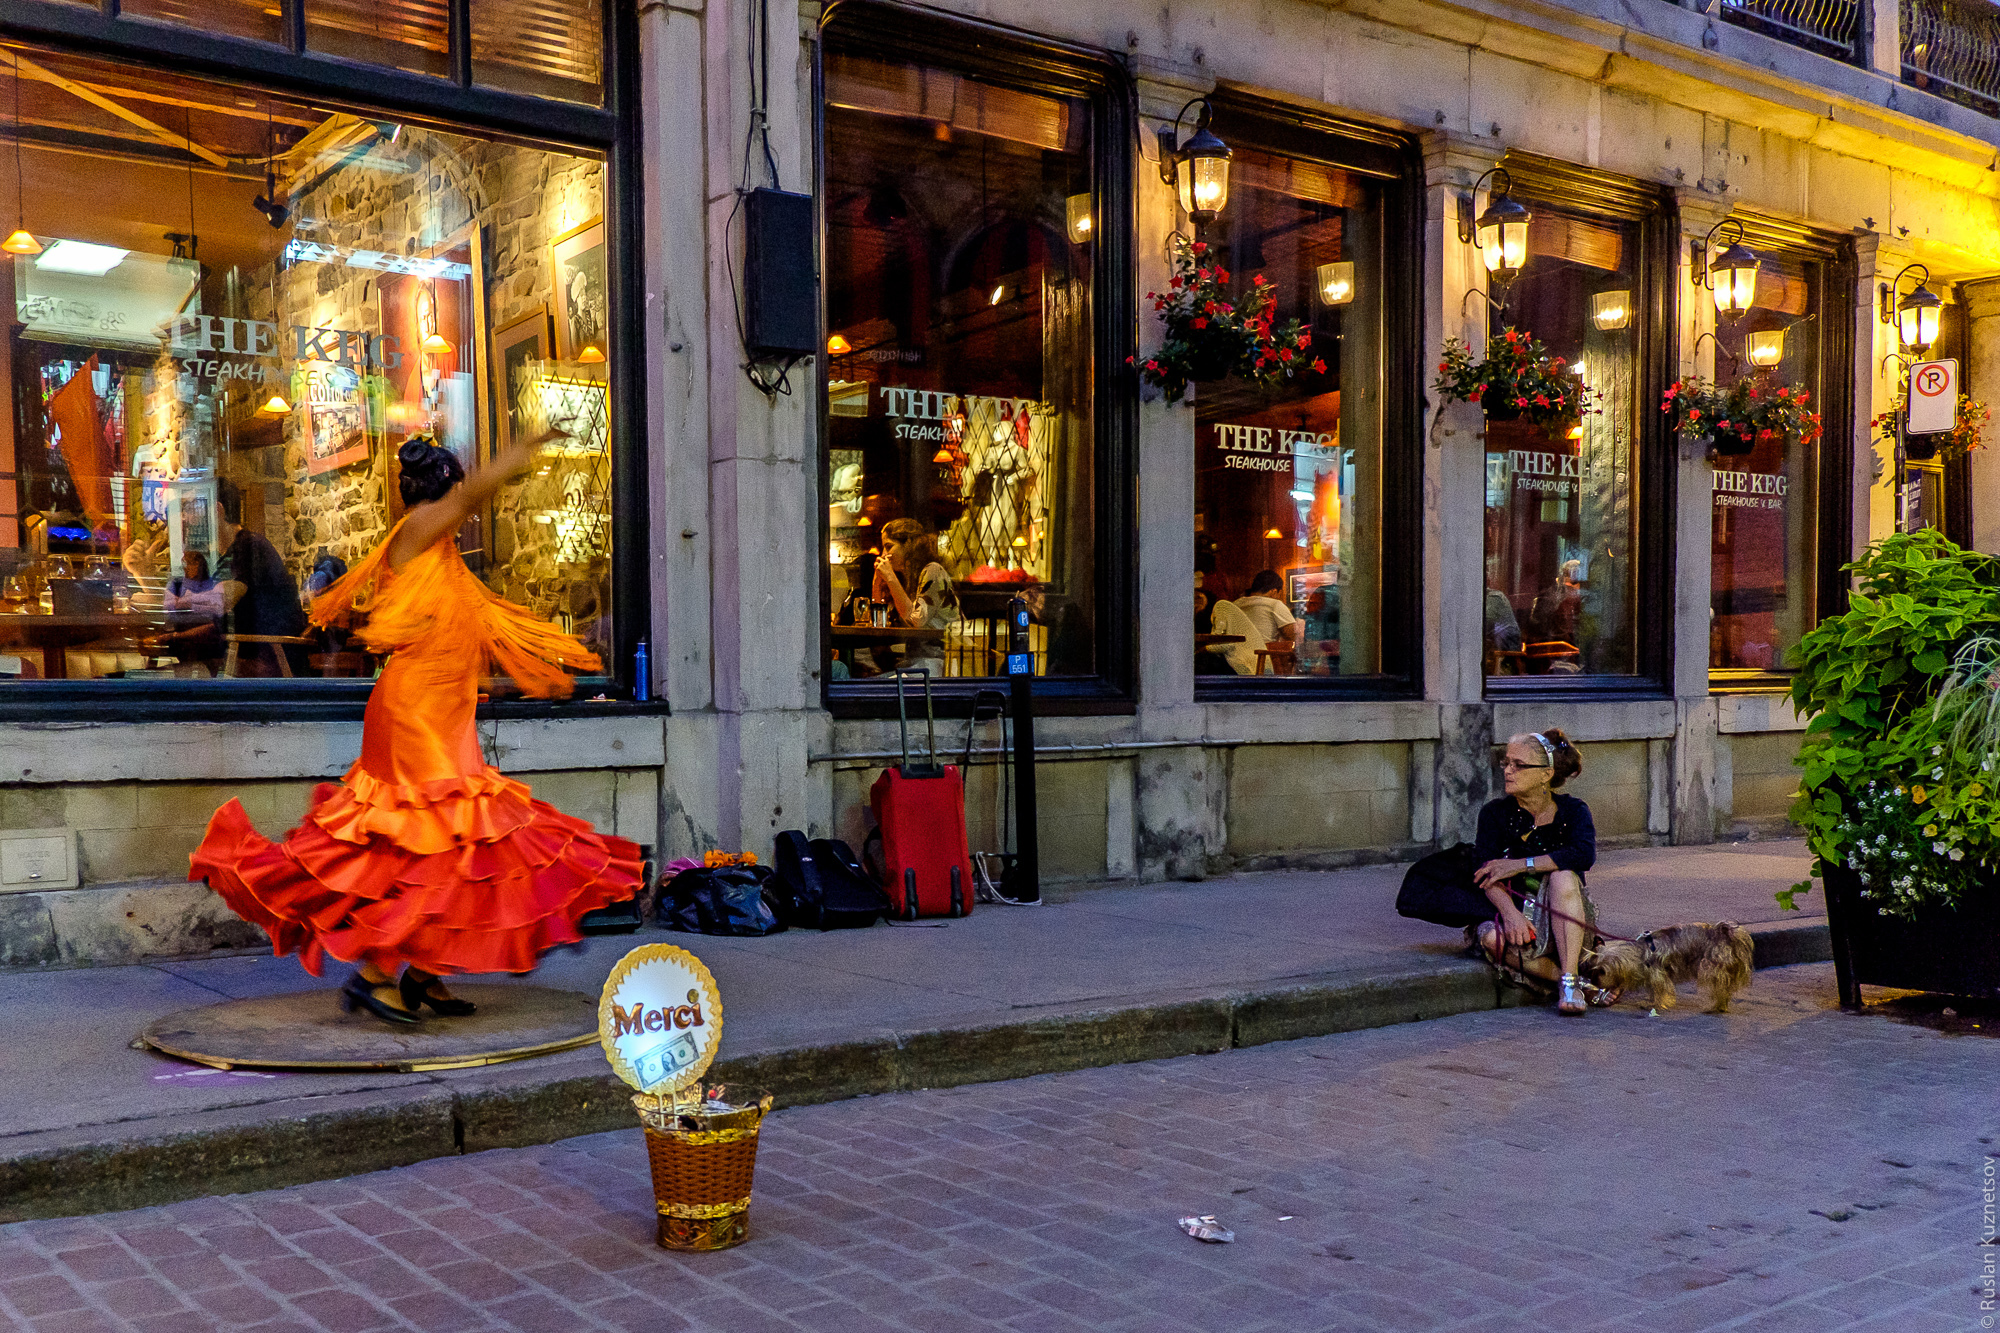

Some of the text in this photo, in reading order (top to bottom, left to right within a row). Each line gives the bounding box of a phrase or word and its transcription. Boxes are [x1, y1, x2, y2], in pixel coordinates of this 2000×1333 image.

[171, 313, 404, 370] THE KEG
[880, 386, 957, 421] THE
[1214, 423, 1272, 454] THE
[1225, 455, 1291, 472] STEAKHOUSE
[1508, 449, 1555, 476] THE
[1517, 478, 1570, 493] STEAKHOUSE
[1712, 469, 1788, 496] THE KEG
[1716, 494, 1759, 508] STEAKHOUSE
[1768, 499, 1784, 511] BAR
[1015, 655, 1022, 664] P
[612, 989, 705, 1038] Merci
